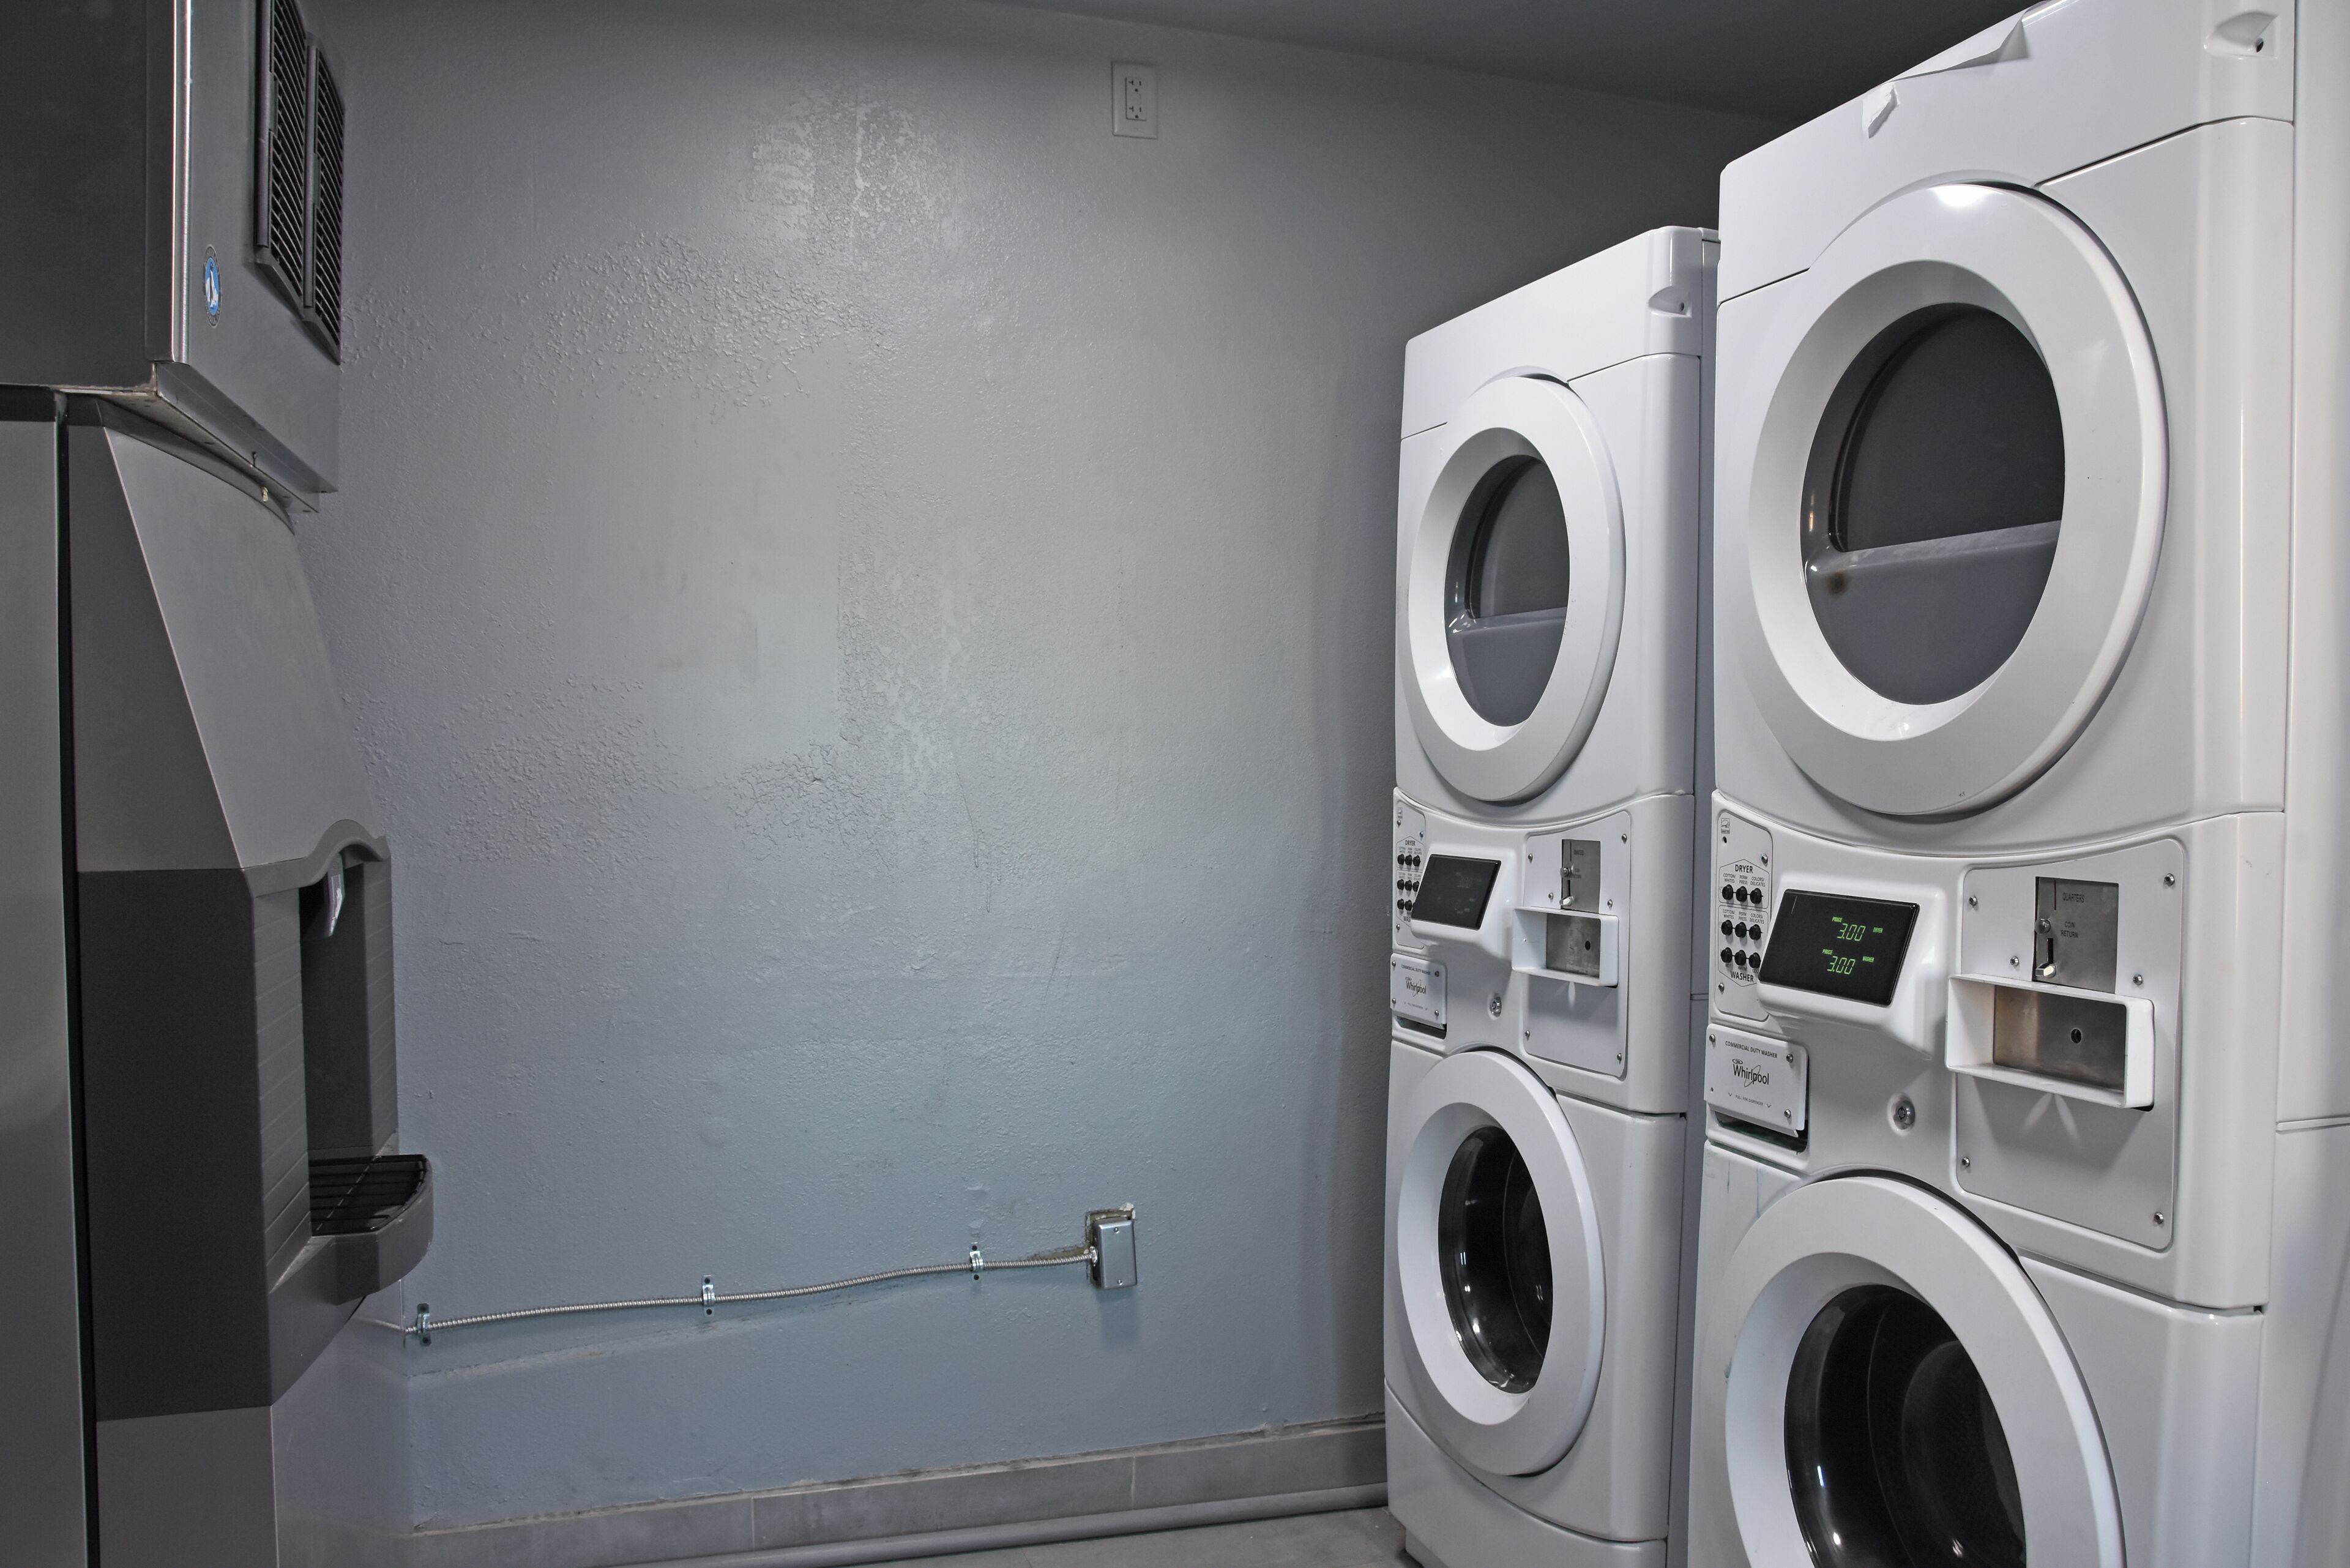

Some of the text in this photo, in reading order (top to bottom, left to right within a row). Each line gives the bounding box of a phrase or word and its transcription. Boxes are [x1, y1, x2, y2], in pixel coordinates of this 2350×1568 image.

[1735, 864, 1753, 873] DRYER
[2062, 892, 2085, 903] QUARTERS
[1837, 923, 1866, 941] 3.00
[1827, 955, 1856, 974] 3.00
[1730, 971, 1754, 982] WASHER
[1406, 980, 1426, 994] Whirlpool
[1725, 1040, 1750, 1051] COMMERCIAL
[1761, 1050, 1777, 1058] WASHER
[1733, 1064, 1769, 1085] Whirlpool
